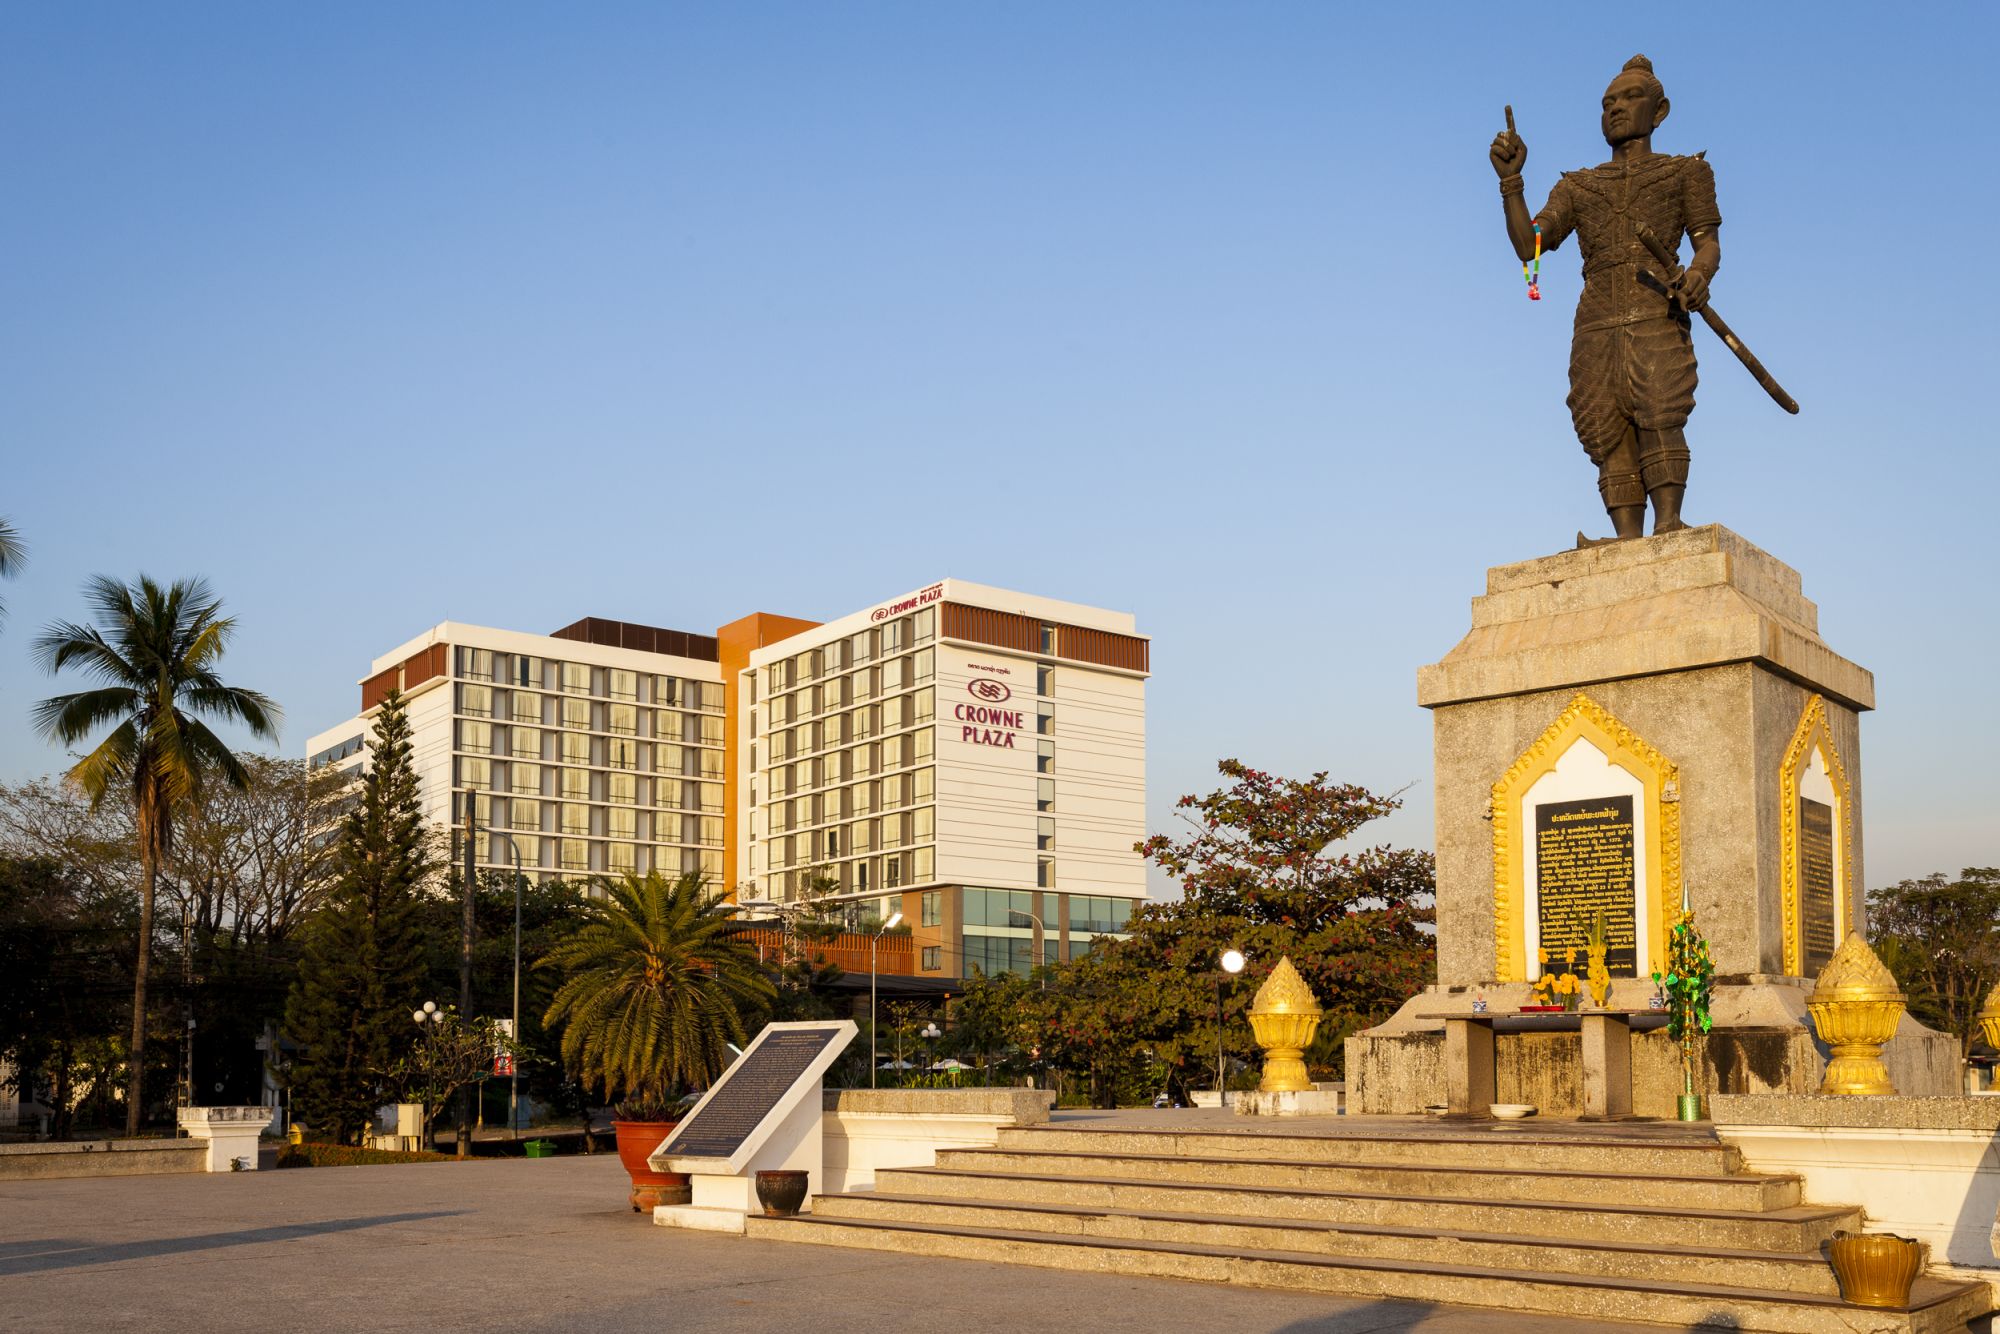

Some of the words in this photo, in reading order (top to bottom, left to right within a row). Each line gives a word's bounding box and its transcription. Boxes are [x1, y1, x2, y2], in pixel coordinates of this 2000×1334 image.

[889, 597, 918, 616] CROWNE
[920, 589, 943, 605] PLAZA
[955, 703, 1024, 729] CROWNE
[962, 725, 1015, 749] PLAZA
